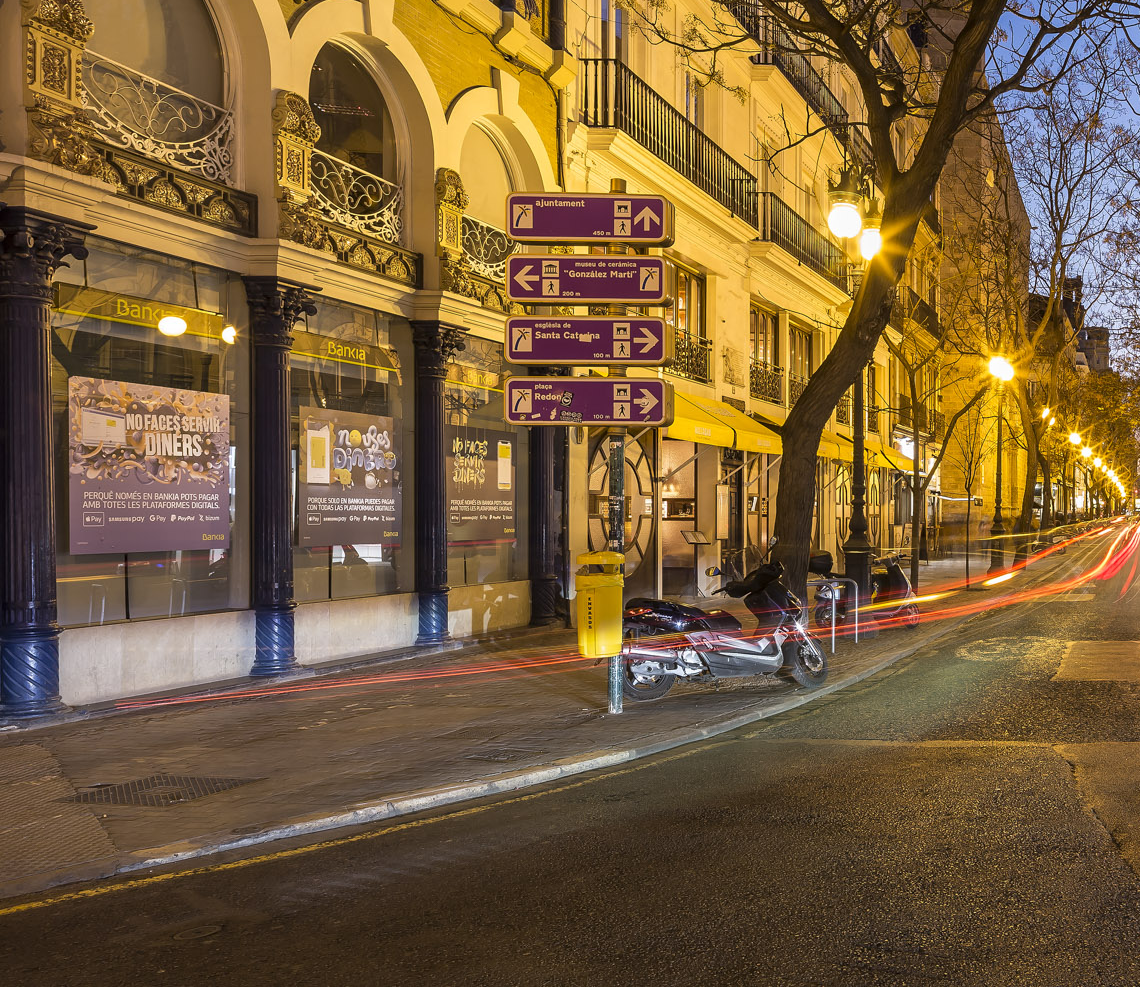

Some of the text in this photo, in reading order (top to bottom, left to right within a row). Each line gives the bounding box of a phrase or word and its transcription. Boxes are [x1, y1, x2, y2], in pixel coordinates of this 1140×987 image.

[535, 199, 586, 208] ajuntament
[117, 299, 173, 323] Bank
[534, 331, 561, 340] Santa
[328, 340, 366, 361] Bankia
[467, 369, 494, 387] Bankia
[534, 383, 553, 391] plaça
[534, 393, 563, 402] Redon
[126, 413, 220, 433] NO FACES SERVIR
[145, 433, 202, 457] DINERS
[464, 440, 489, 457] FACES
[453, 452, 485, 469] SERVIR
[452, 467, 486, 486] DINERS
[115, 491, 142, 501] NOMÉS
[142, 492, 153, 500] EN
[154, 492, 179, 501] BANKIA
[180, 493, 198, 501] POTS
[198, 493, 220, 501] PAGAR
[82, 501, 221, 509] AMB TOTES LES PLATAFORMES DIGITALS.
[307, 497, 328, 505] PORQUE
[90, 515, 102, 523] Pay
[156, 515, 167, 523] Pay
[202, 533, 225, 541] Bankia
